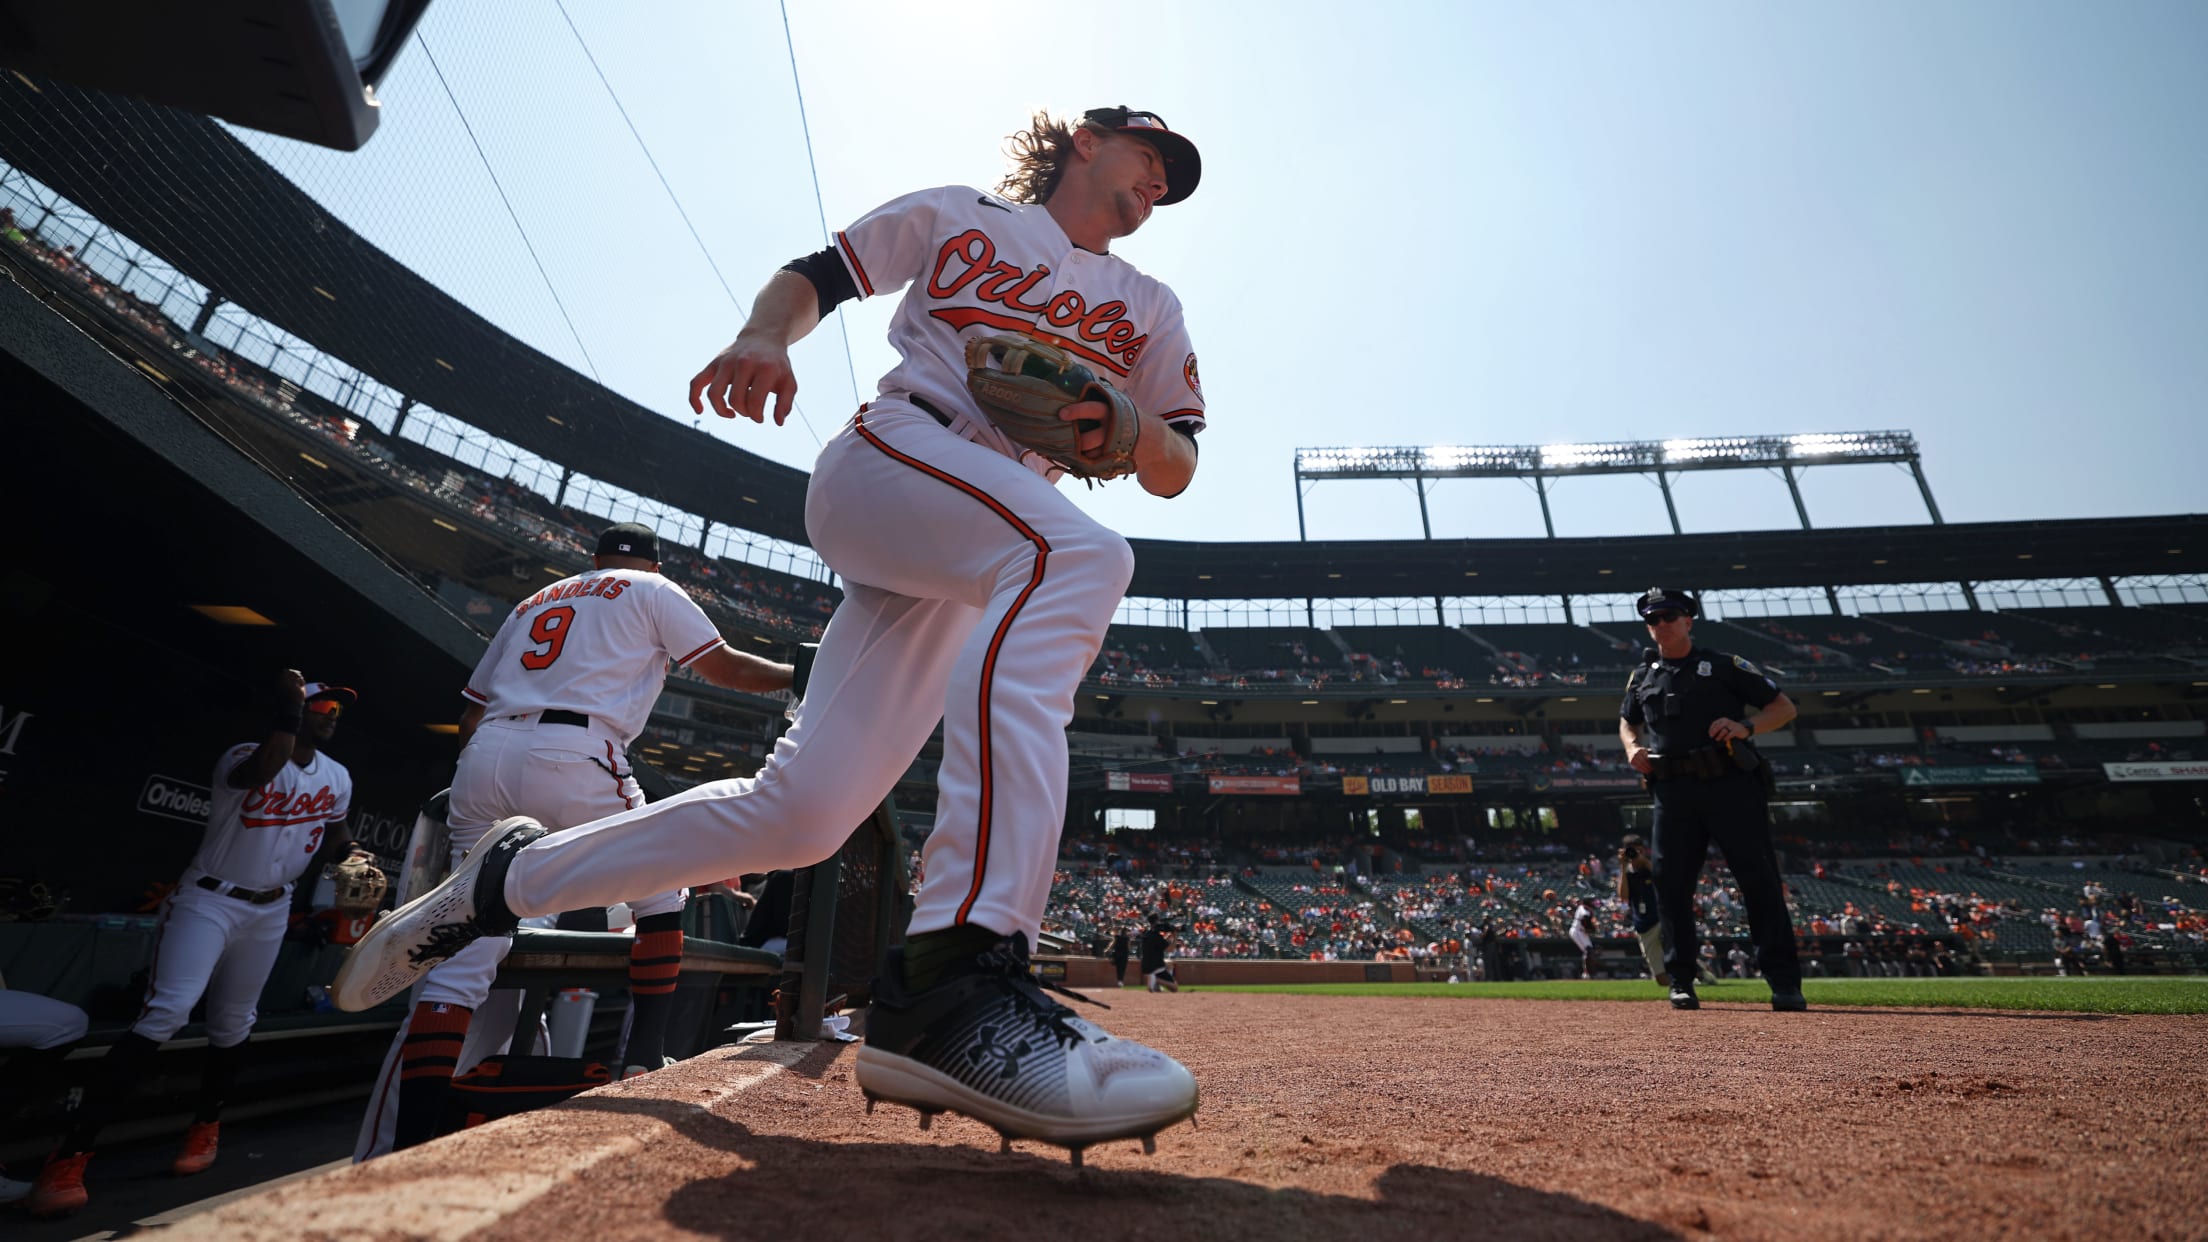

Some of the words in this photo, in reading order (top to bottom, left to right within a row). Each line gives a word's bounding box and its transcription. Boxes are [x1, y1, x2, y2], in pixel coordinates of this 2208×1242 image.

[927, 229, 1149, 366] Orioles
[516, 577, 631, 619] SANDERS
[520, 605, 576, 671] 9
[146, 783, 212, 818] Orioles
[242, 781, 335, 816] Oriole
[1371, 778, 1397, 793] OLD
[1400, 777, 1424, 793] BAY
[1431, 775, 1469, 791] SEASON
[304, 826, 323, 853] 3
